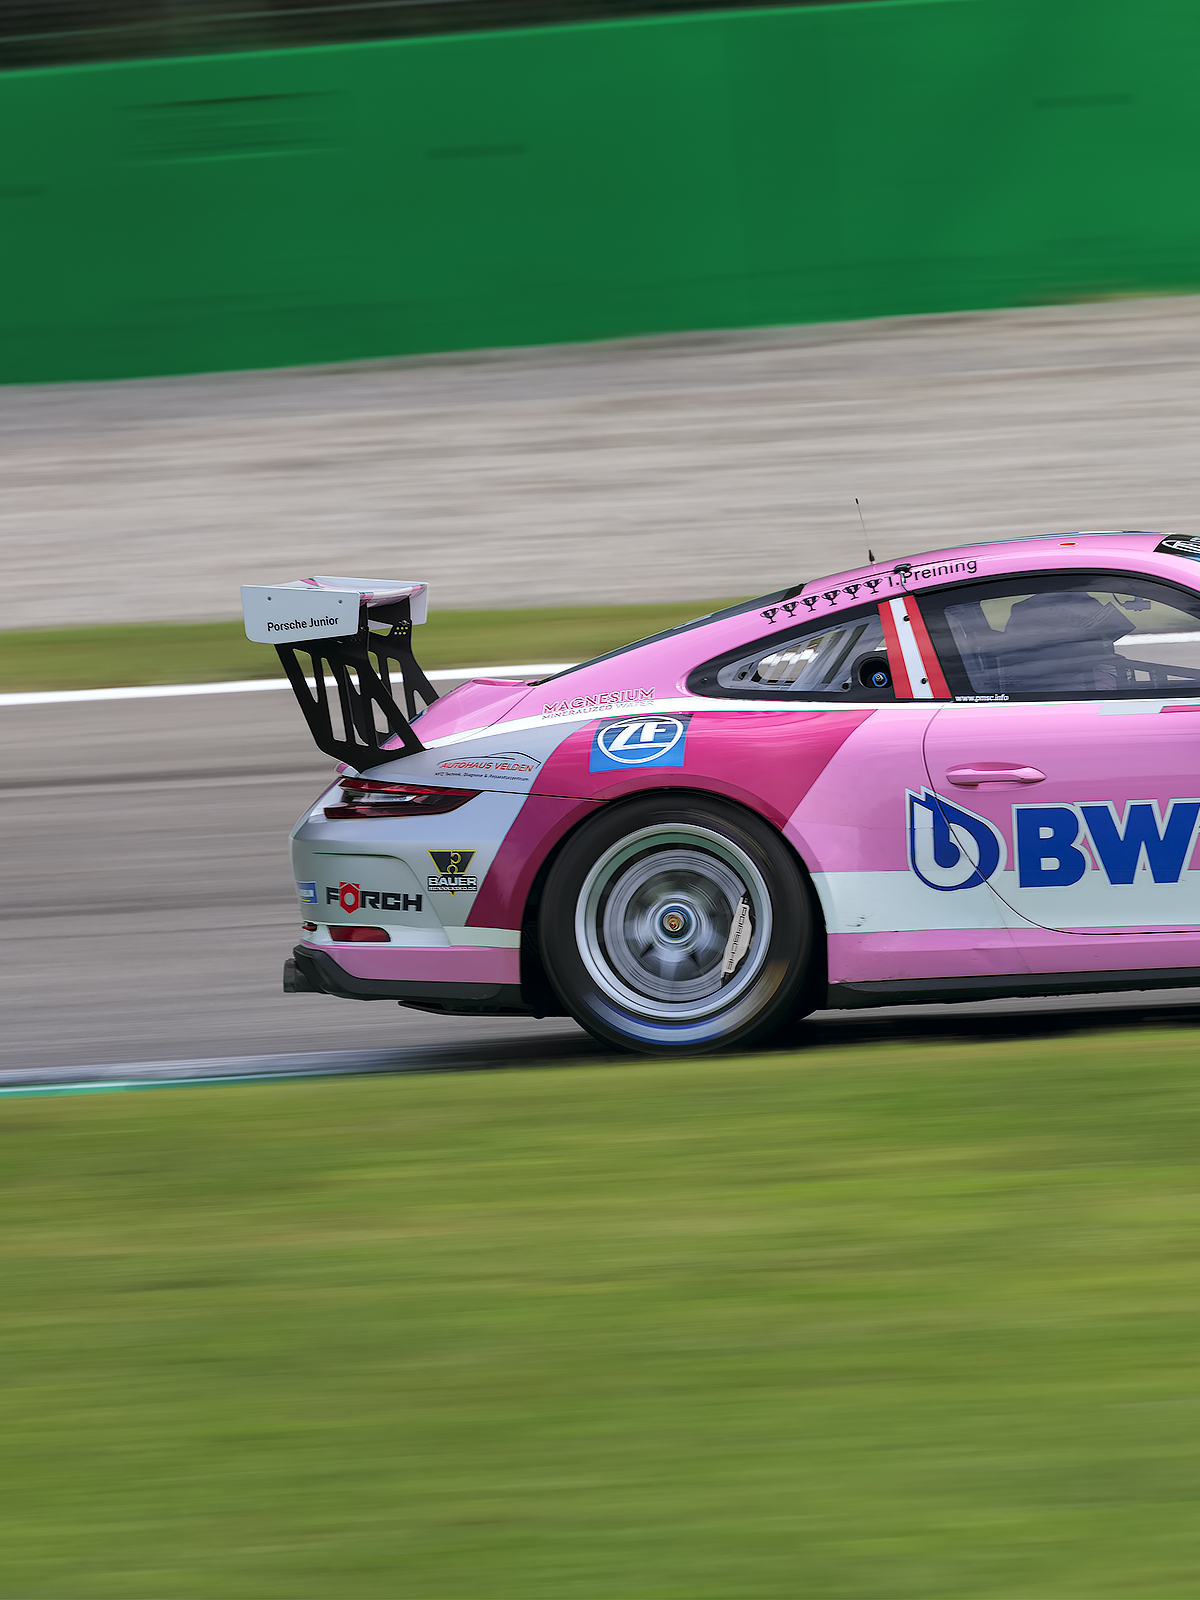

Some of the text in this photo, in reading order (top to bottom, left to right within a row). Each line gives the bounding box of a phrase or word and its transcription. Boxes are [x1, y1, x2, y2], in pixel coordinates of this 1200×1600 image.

[267, 615, 339, 632] Porsche Junior
[542, 687, 656, 714] MAGNESIUM
[542, 704, 612, 719] MINERALIZED
[602, 720, 678, 756] ZF
[439, 761, 534, 772] AUTOHAUS VELDEN
[428, 877, 477, 886] BAUER
